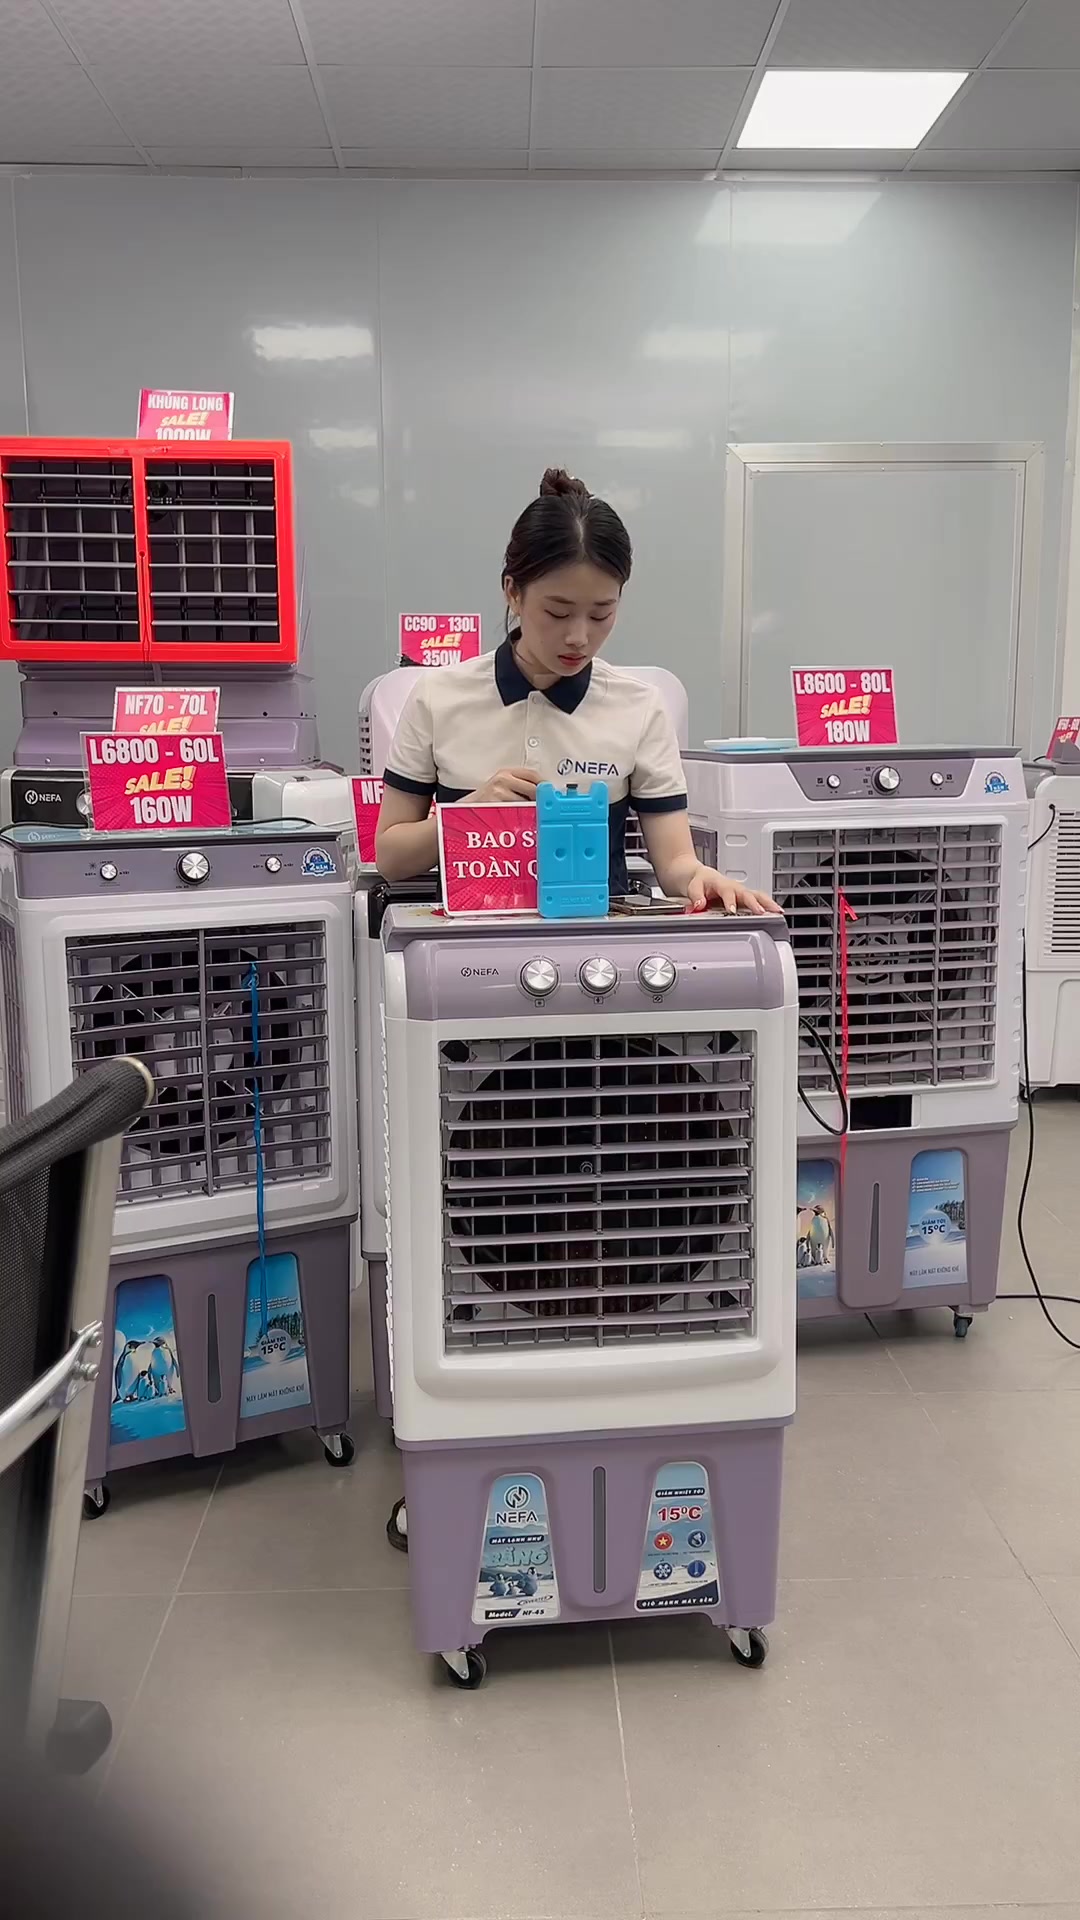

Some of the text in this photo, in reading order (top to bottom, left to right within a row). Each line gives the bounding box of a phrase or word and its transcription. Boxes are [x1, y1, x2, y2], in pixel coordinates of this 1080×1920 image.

[192, 397, 224, 411] LONG
[160, 411, 208, 426] SALE!
[156, 427, 211, 440] 1000W
[404, 616, 437, 632] CC90
[448, 616, 477, 632] 130L
[420, 632, 463, 649] SALE!
[422, 649, 461, 666] 350W
[795, 672, 846, 694] L8600
[860, 672, 891, 693] 80L
[124, 694, 164, 715] NF70
[179, 694, 208, 715] 70L
[820, 694, 873, 719] SALE!
[139, 716, 194, 734] SALE!
[825, 720, 870, 743] 180W
[89, 738, 159, 765] L6800
[179, 737, 219, 763] 60L
[574, 761, 619, 776] NEFA
[124, 765, 197, 795] SALE!
[39, 793, 62, 802] NEFA
[130, 796, 192, 824] 160W
[466, 830, 537, 849] BAO S
[453, 856, 520, 879] TOÀN
[473, 968, 499, 976] NEFA
[496, 1509, 538, 1524] NEFA
